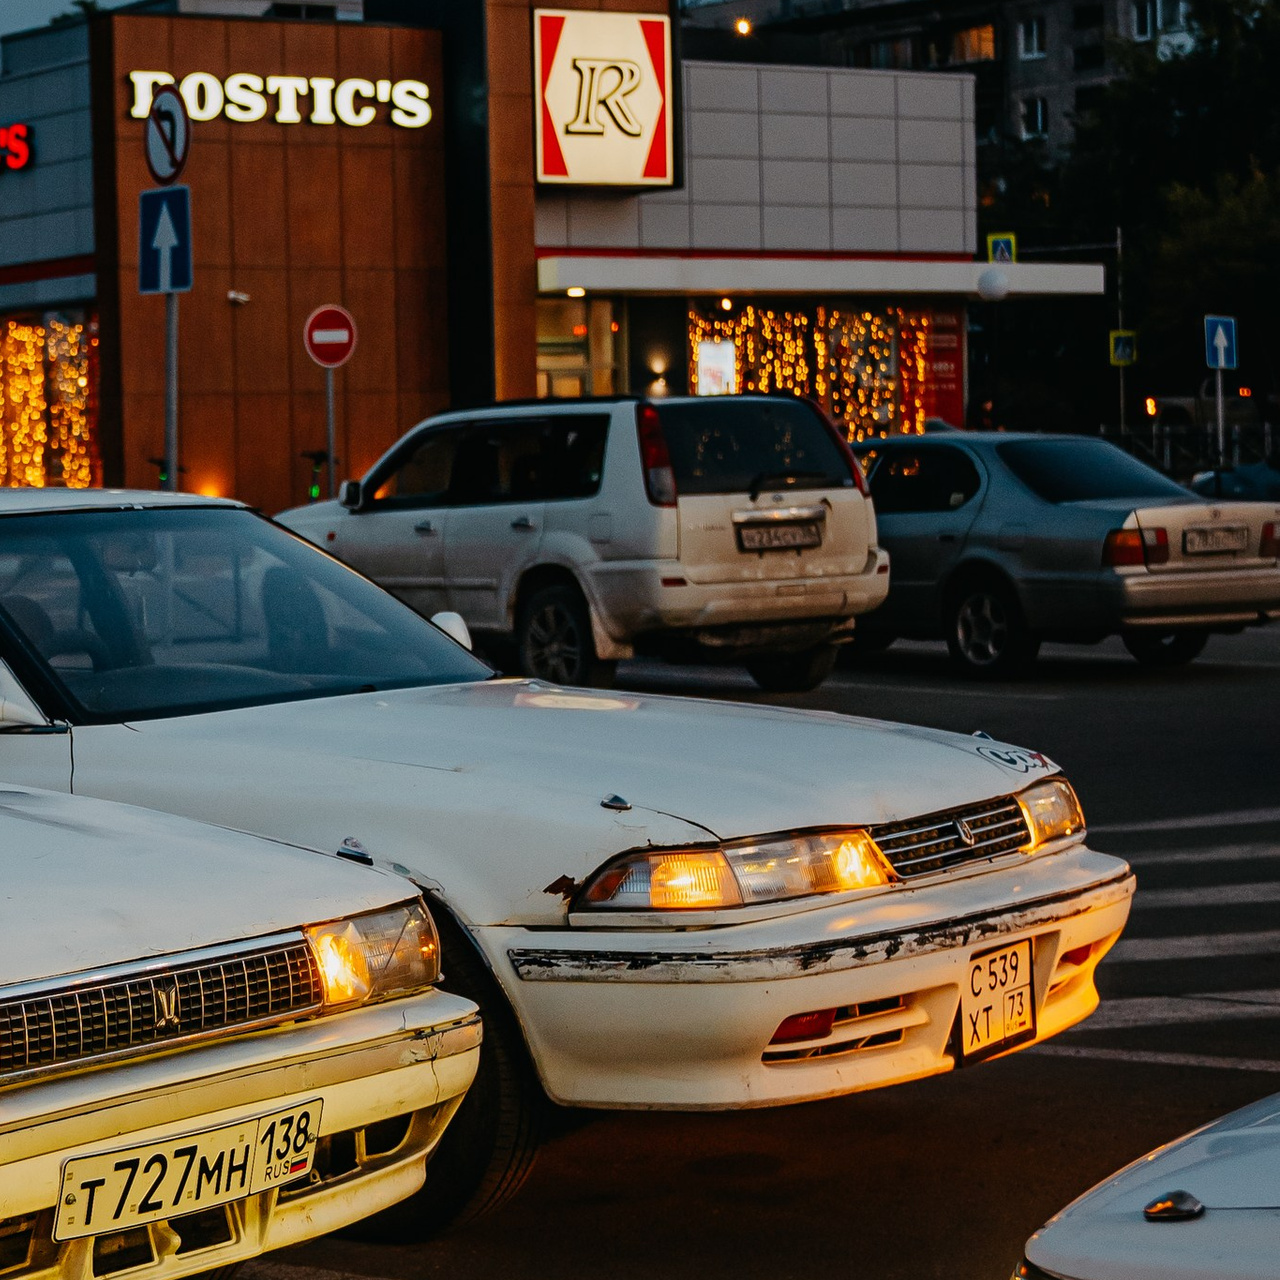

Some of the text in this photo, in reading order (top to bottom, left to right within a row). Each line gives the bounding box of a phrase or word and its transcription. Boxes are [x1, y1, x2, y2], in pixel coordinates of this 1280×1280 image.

[564, 57, 642, 138] R
[1008, 991, 1024, 1020] 73
[260, 1111, 311, 1164] 138
[264, 1159, 290, 1182] RUS
